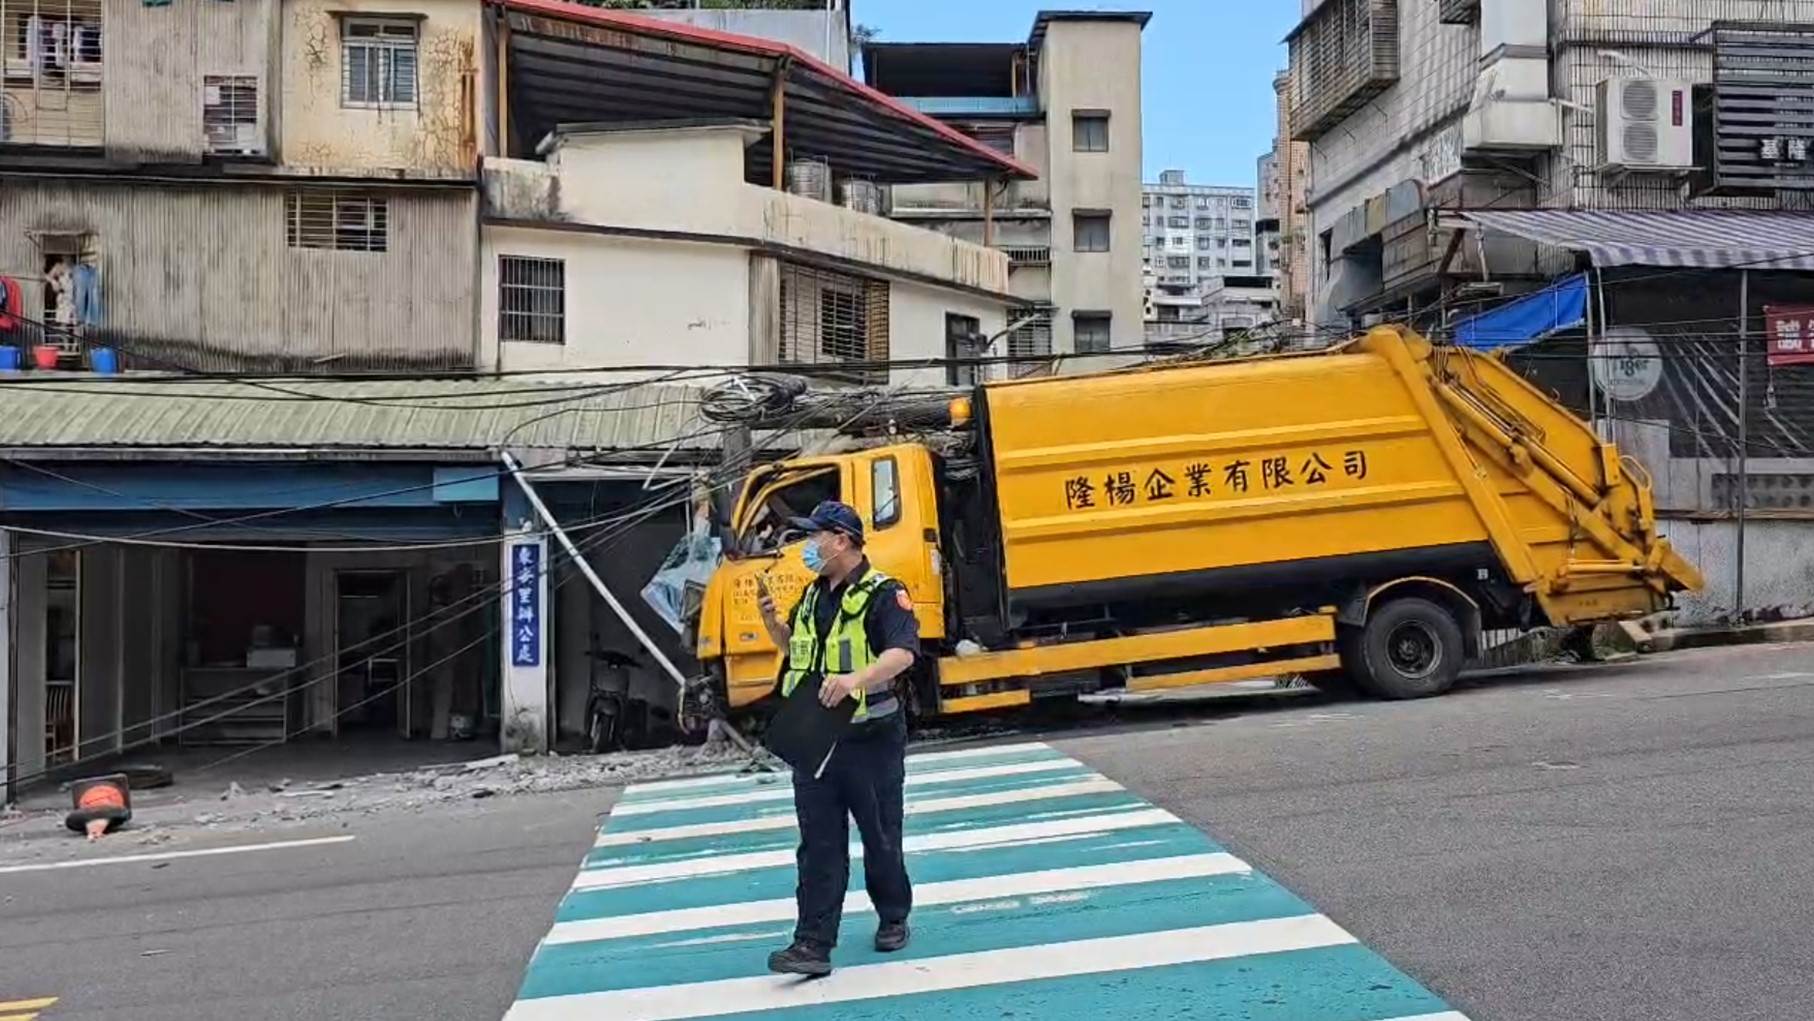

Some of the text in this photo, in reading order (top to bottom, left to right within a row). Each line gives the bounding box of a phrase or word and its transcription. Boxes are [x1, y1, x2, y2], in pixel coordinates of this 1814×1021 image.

[1064, 450, 1367, 511] 隆楊企業有限公司
